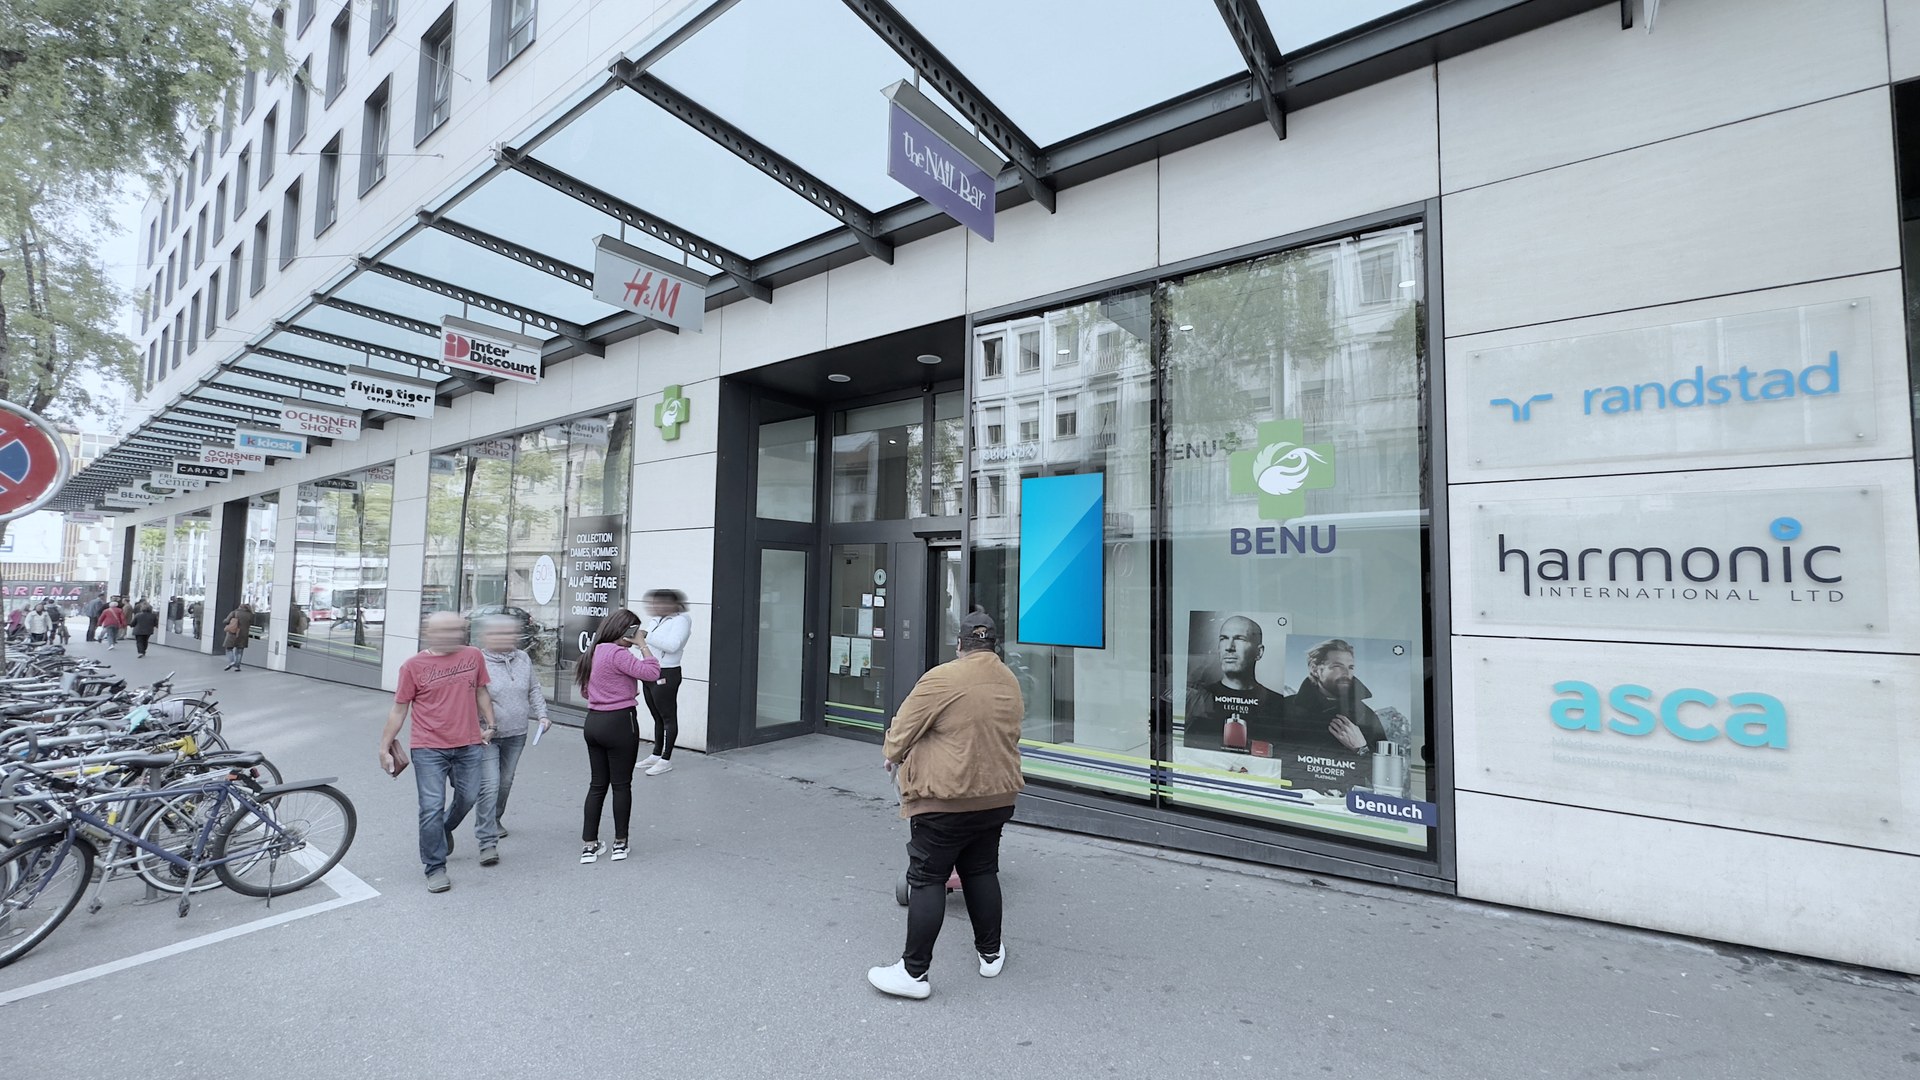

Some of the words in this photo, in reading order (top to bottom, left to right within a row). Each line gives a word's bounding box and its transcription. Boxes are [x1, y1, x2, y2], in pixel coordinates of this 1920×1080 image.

[903, 131, 925, 168] the
[958, 171, 986, 211] Bar
[623, 268, 682, 319] H&M
[471, 339, 510, 358] Inter
[469, 351, 537, 376] Discount
[1583, 350, 1841, 415] randstad
[350, 380, 394, 397] flying
[396, 388, 431, 404] tiger
[367, 396, 415, 408] copenhagen
[285, 410, 357, 429] OCHSNER
[300, 422, 342, 435] SHOES
[257, 437, 296, 451] kiosk
[204, 456, 241, 466] SPORT
[207, 450, 262, 462] OCHSNER
[179, 466, 214, 475] CARAT
[158, 478, 200, 488] centre
[120, 491, 151, 500] BENU
[577, 533, 612, 543] COLLECTION
[1230, 525, 1336, 555] BENU
[570, 547, 592, 558] DAMES,
[591, 546, 618, 557] HOMMES
[1498, 516, 1843, 596] harmonic
[576, 561, 583, 571] ET
[584, 561, 611, 571] ENFANTS
[568, 577, 578, 588] AU
[593, 573, 618, 589] ÉTAGE
[2, 586, 82, 596] ARENA
[576, 592, 584, 602] DU
[585, 592, 608, 603] CENTRE
[1540, 586, 1760, 601] INTERNATIONAL
[1790, 590, 1844, 603] LTD
[1215, 696, 1259, 706] MONTBLANC
[1223, 704, 1249, 712] LEGEND
[1550, 680, 1790, 750] asca
[1297, 754, 1356, 770] MONTBLANC
[1306, 764, 1345, 777] EXPLORER
[1314, 773, 1337, 781] PLATINUM
[1355, 795, 1423, 820] benu.ch
